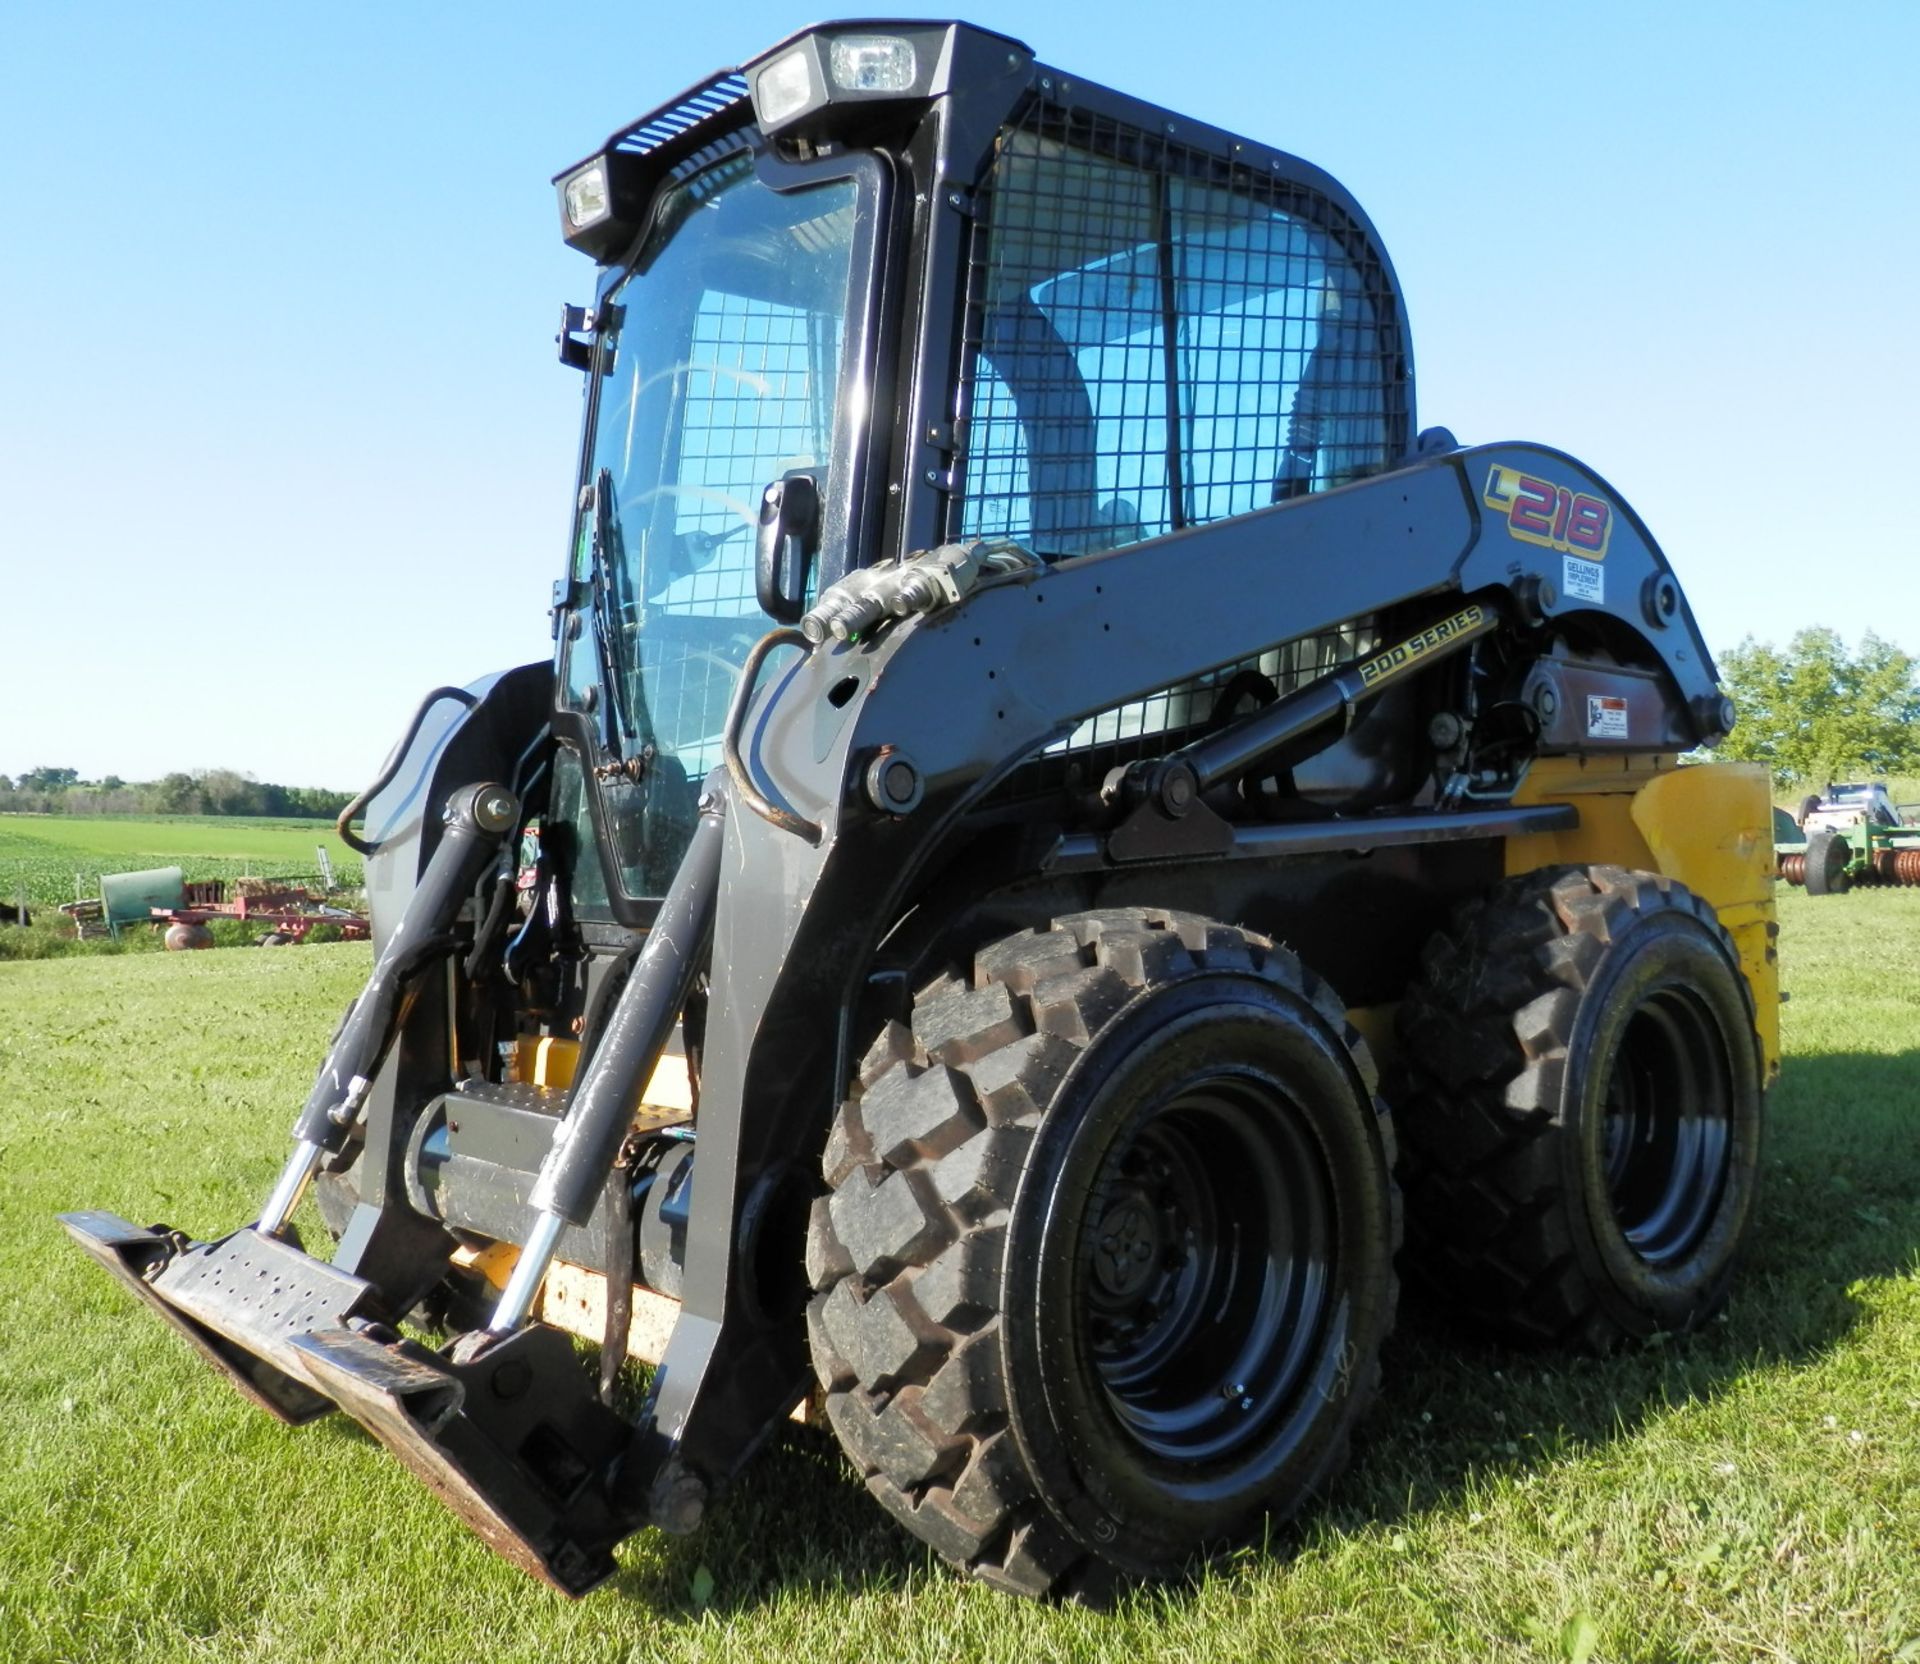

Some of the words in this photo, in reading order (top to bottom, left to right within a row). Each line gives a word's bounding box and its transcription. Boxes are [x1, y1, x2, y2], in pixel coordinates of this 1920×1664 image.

[1567, 561, 1600, 578] GELLINGS
[1567, 571, 1599, 587] IMPLEMENT
[1361, 647, 1407, 680] 200
[1408, 607, 1482, 656] SERIES
